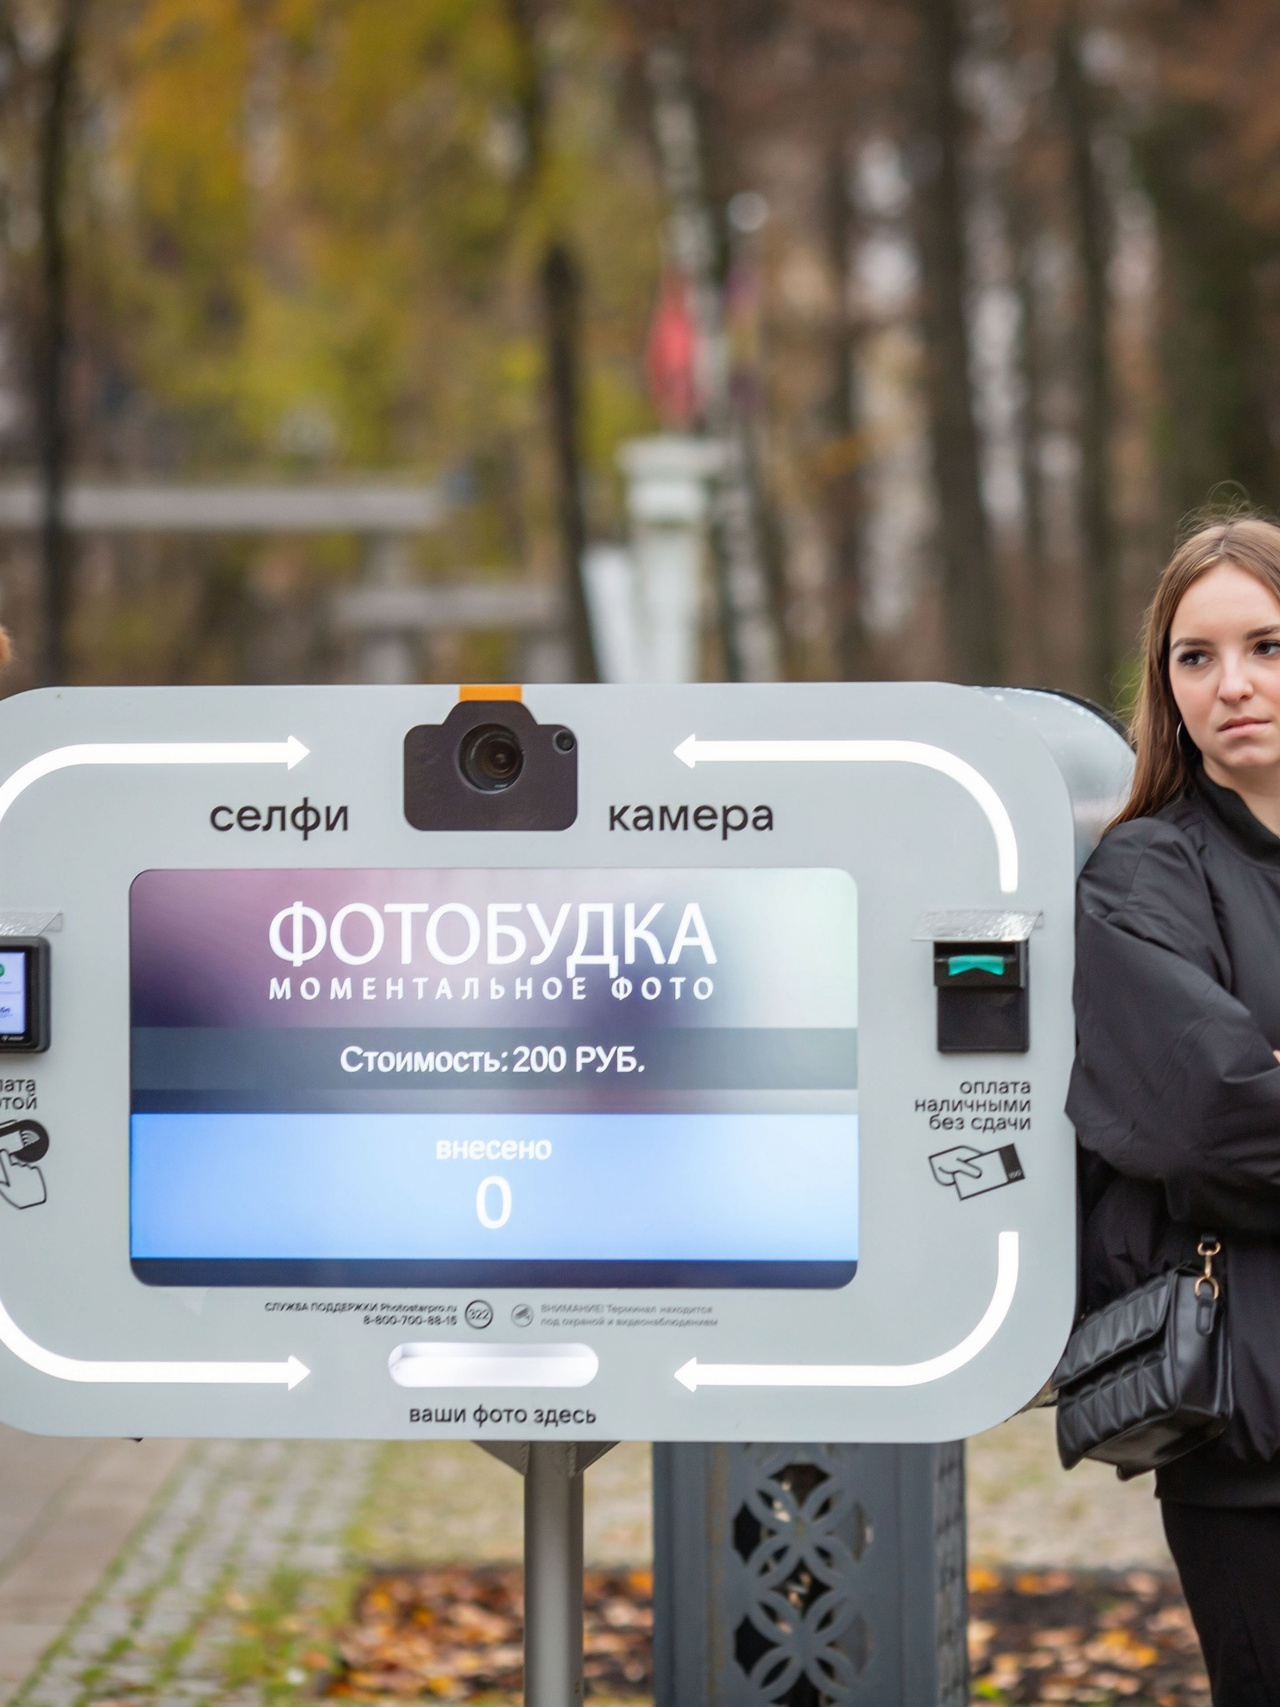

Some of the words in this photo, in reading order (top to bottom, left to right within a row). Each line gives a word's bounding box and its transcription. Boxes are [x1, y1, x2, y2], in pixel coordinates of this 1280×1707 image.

[210, 796, 349, 842] селфи
[609, 804, 774, 842] камера
[269, 901, 717, 978] ФОТОБУДКА
[269, 977, 587, 1000] МОМЕНТАЛЬНОЕ
[611, 976, 715, 1001] ФОТО
[576, 1045, 646, 1073] РУБ.
[959, 1080, 1032, 1095] оплата
[914, 1098, 1032, 1113] наличными
[928, 1113, 965, 1131] без
[970, 1116, 1032, 1134] сдачи
[435, 1140, 553, 1161] внесено
[475, 1175, 513, 1230] 0
[264, 1301, 309, 1313] СЛУЖБА
[310, 1301, 378, 1314] ПОДДЕРЖКИ
[409, 1408, 467, 1424] ваши
[472, 1403, 528, 1429] фото
[533, 1408, 597, 1428] здесь
